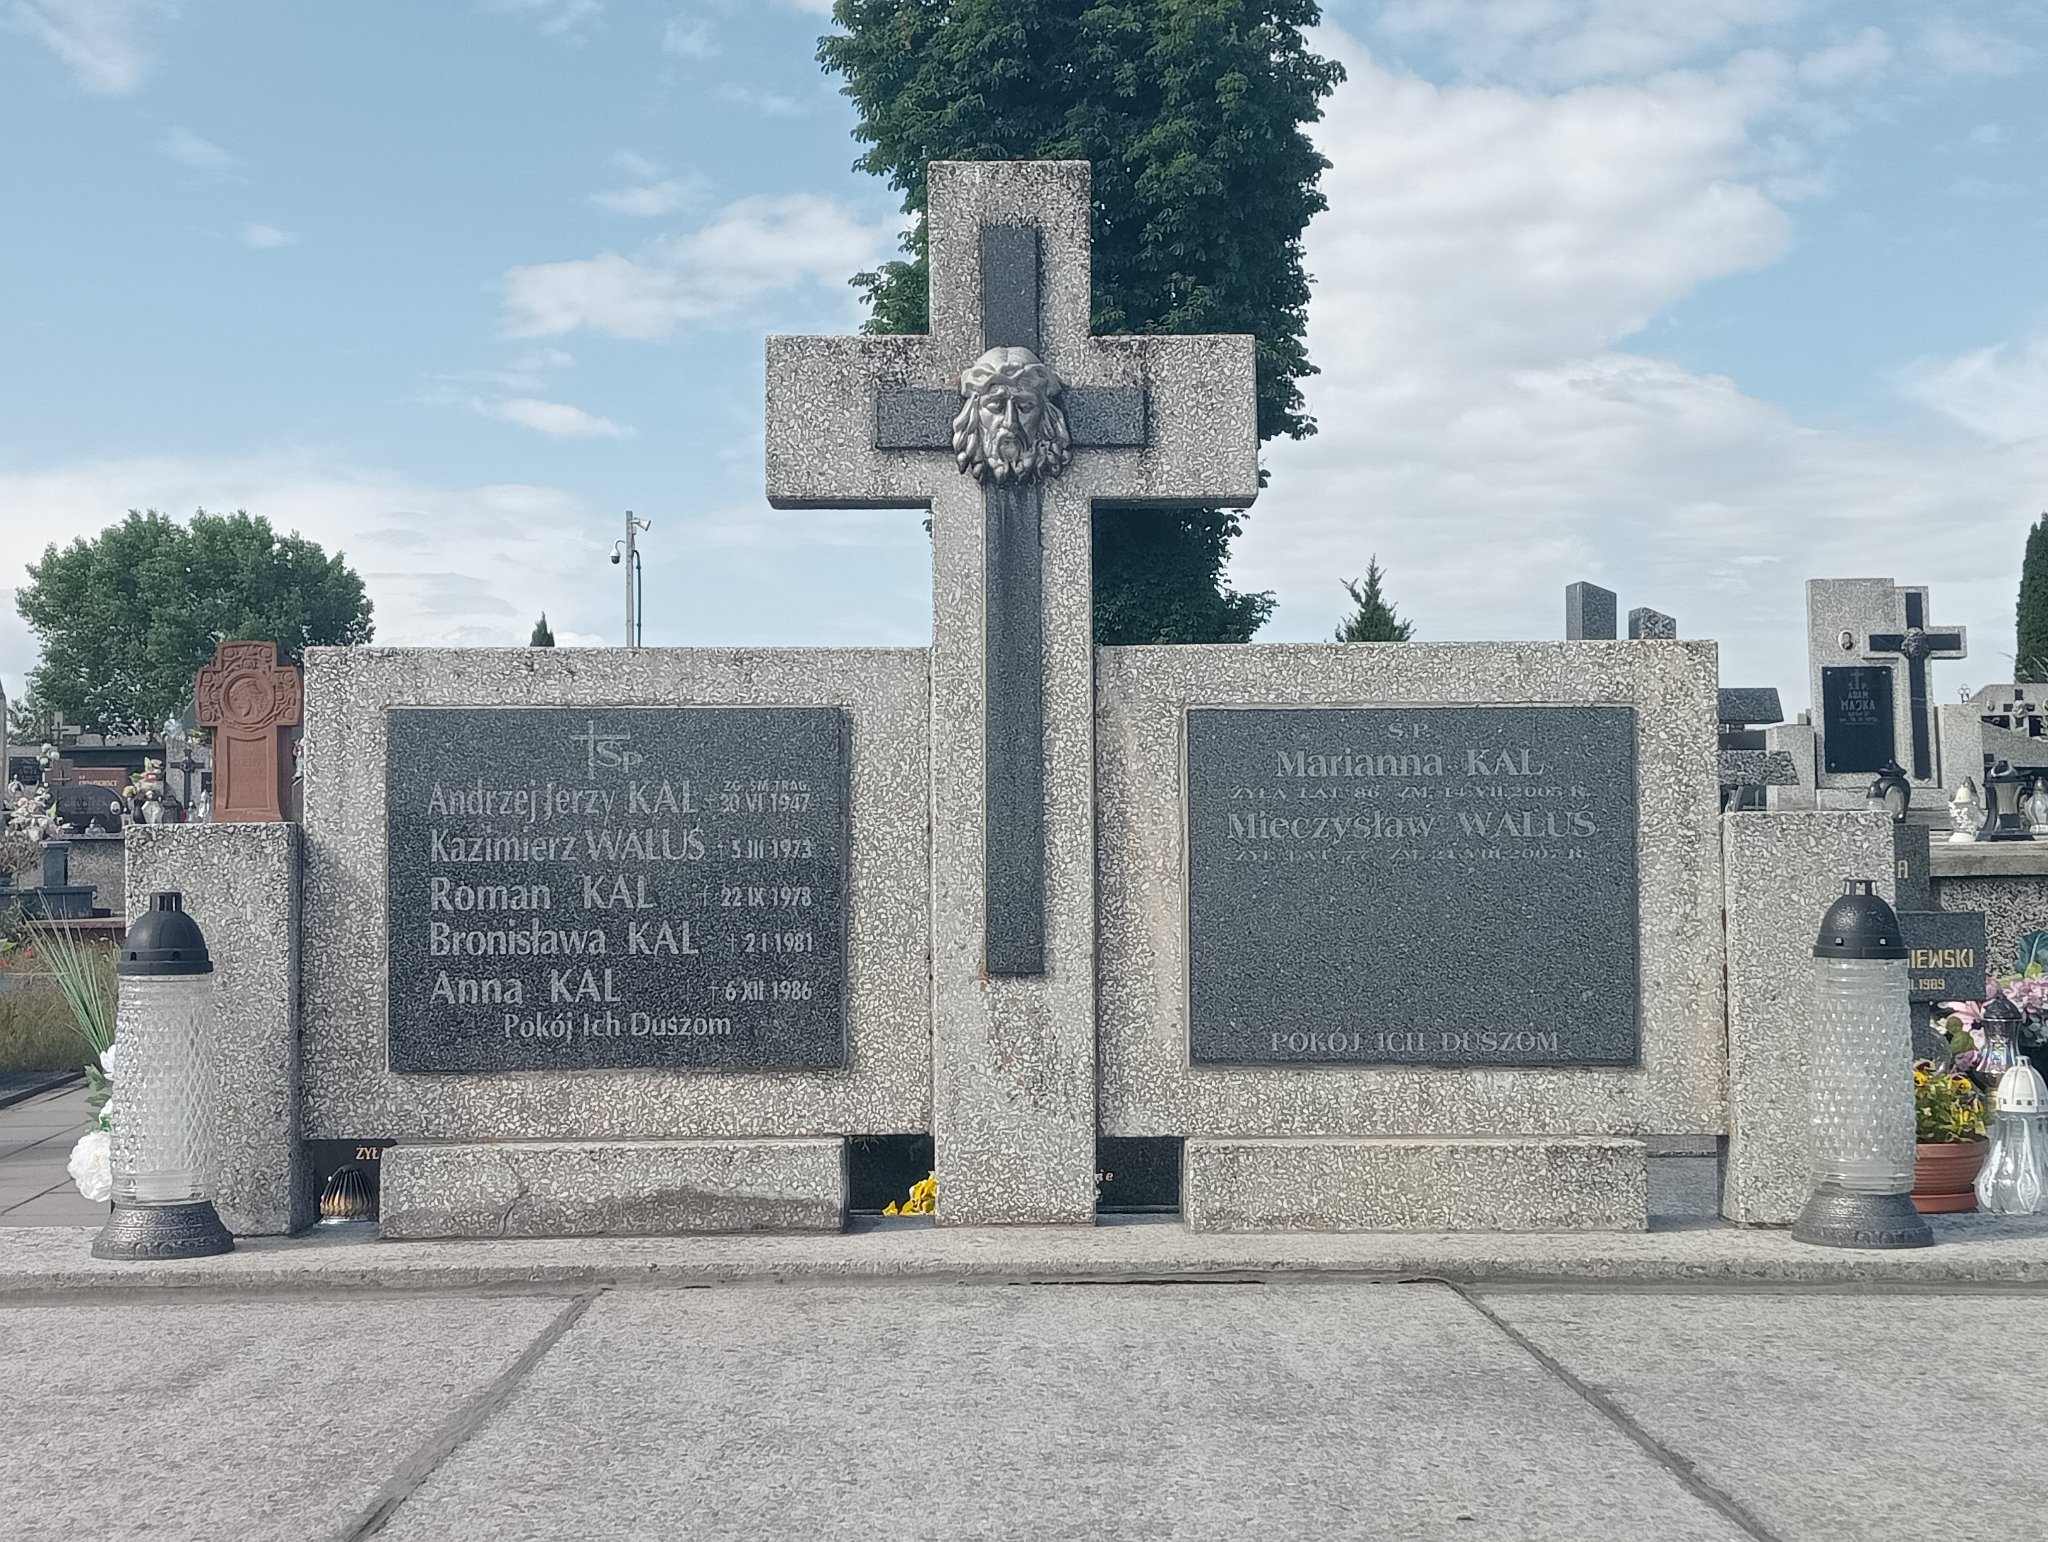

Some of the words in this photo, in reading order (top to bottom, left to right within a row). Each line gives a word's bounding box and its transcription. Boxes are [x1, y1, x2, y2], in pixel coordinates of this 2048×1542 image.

[1276, 748, 1443, 778] Marianna
[1467, 748, 1544, 777] KAL
[427, 779, 536, 824] Andrzej
[629, 778, 697, 814] KAL
[1227, 809, 1436, 845] Mieczysław
[430, 827, 576, 862] Kazimierz
[430, 877, 552, 912] Roman
[583, 875, 655, 909] KAL
[721, 886, 742, 907] 22
[748, 886, 765, 906] IX
[769, 886, 812, 907] 1978
[430, 919, 606, 957] Bronisława
[629, 920, 699, 955] KAL
[774, 932, 813, 953] 1981
[1908, 949, 1974, 968] IEWSKI
[429, 971, 524, 1005] Anna
[550, 968, 623, 1002] KAL
[772, 981, 813, 1001] 1986
[505, 1013, 573, 1041] Pokój
[583, 1013, 621, 1037] Ich
[631, 1012, 732, 1037] Duszom
[1271, 1026, 1360, 1051] POKÓJ
[1379, 1032, 1425, 1051] ICH
[1443, 1031, 1558, 1051] DUSZOM
